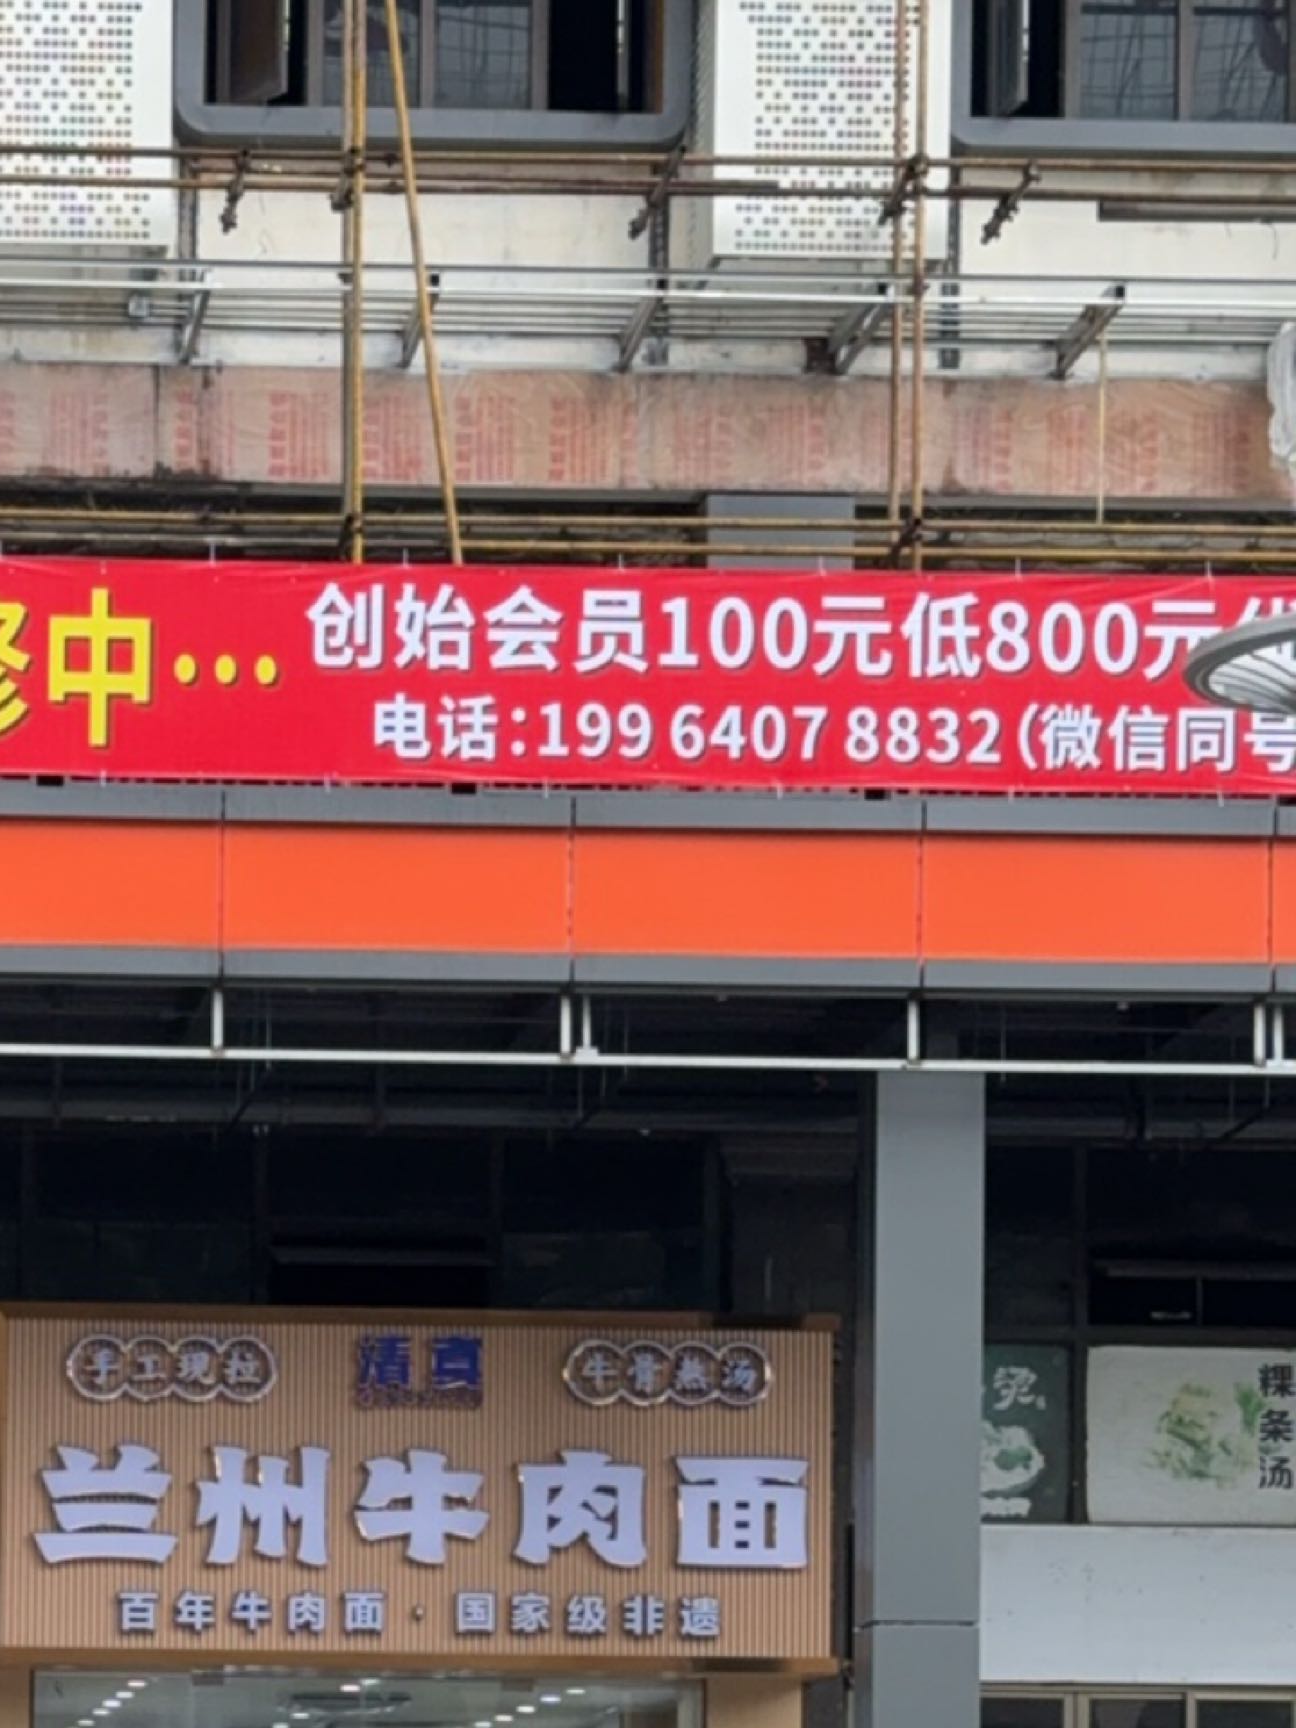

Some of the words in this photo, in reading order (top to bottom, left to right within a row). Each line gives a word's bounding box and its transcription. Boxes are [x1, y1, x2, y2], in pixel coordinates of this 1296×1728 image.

[32, 1443, 811, 1571] 兰州牛肉面
